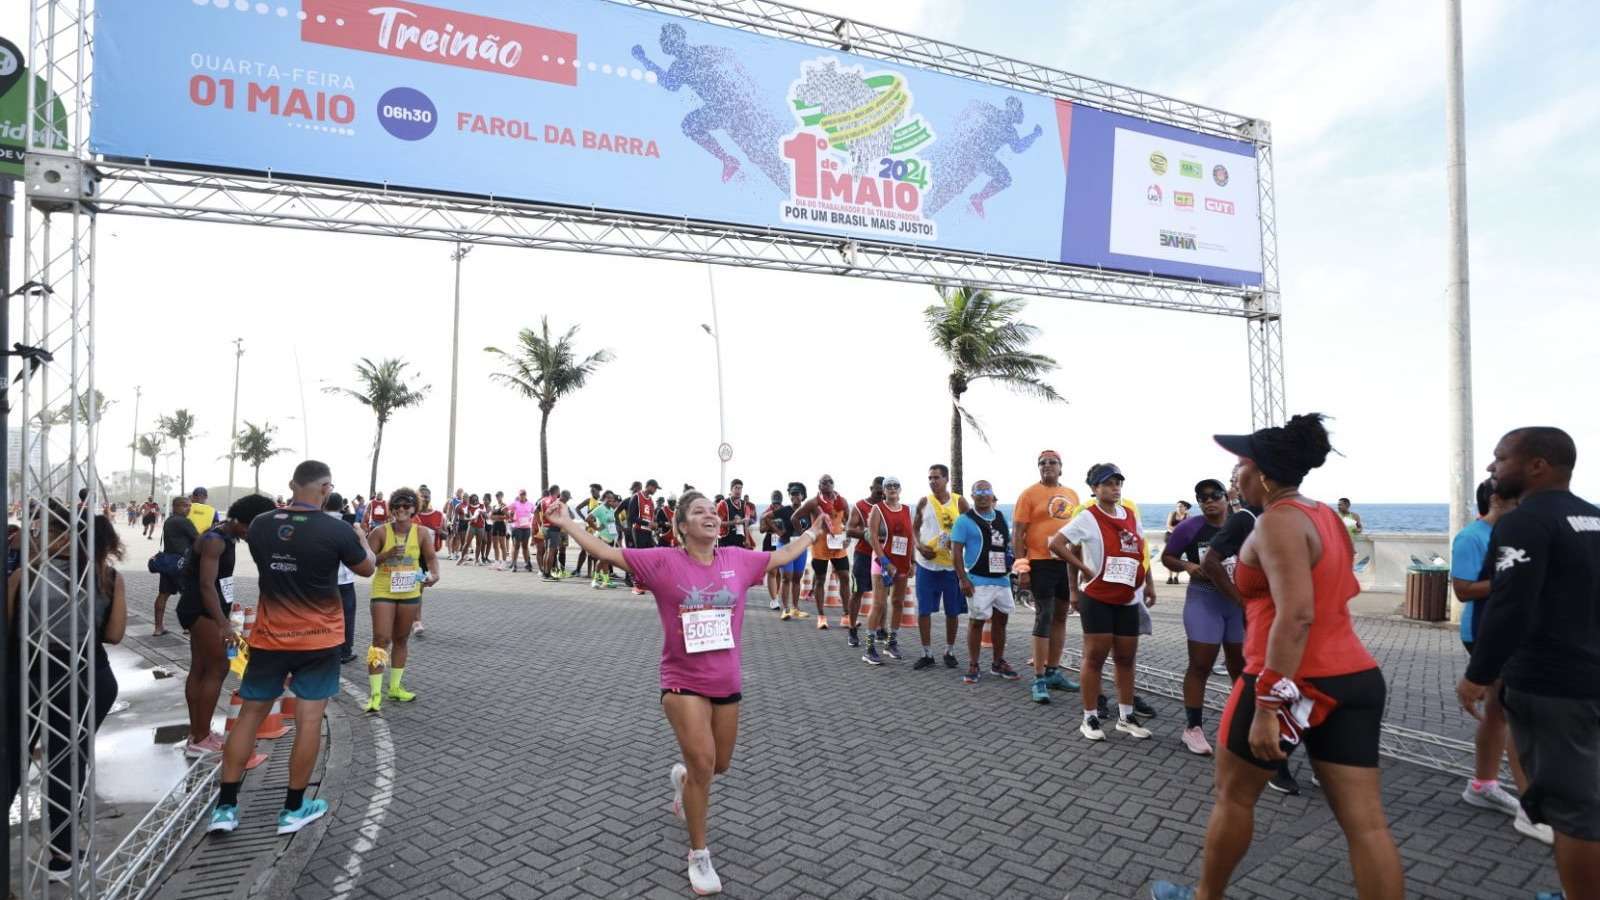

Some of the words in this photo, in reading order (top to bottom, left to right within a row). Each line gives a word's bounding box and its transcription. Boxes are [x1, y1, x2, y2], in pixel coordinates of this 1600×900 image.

[368, 6, 523, 68] Treinão
[190, 52, 356, 91] QUARTA-FEIRA
[189, 74, 235, 109] 01
[247, 82, 356, 125] MAIO
[383, 105, 432, 123] 06h30
[456, 111, 538, 142] FAROL
[543, 123, 577, 147] DA
[582, 130, 660, 159] BARRA
[820, 158, 839, 171] de
[878, 157, 928, 189] 2024
[795, 198, 807, 207] DIA
[820, 169, 919, 212] MAIO
[785, 205, 808, 219] POR
[811, 208, 828, 222] UM
[831, 211, 869, 228] BRASIL
[871, 216, 896, 231] MAIS
[898, 220, 934, 235] JUSTO!
